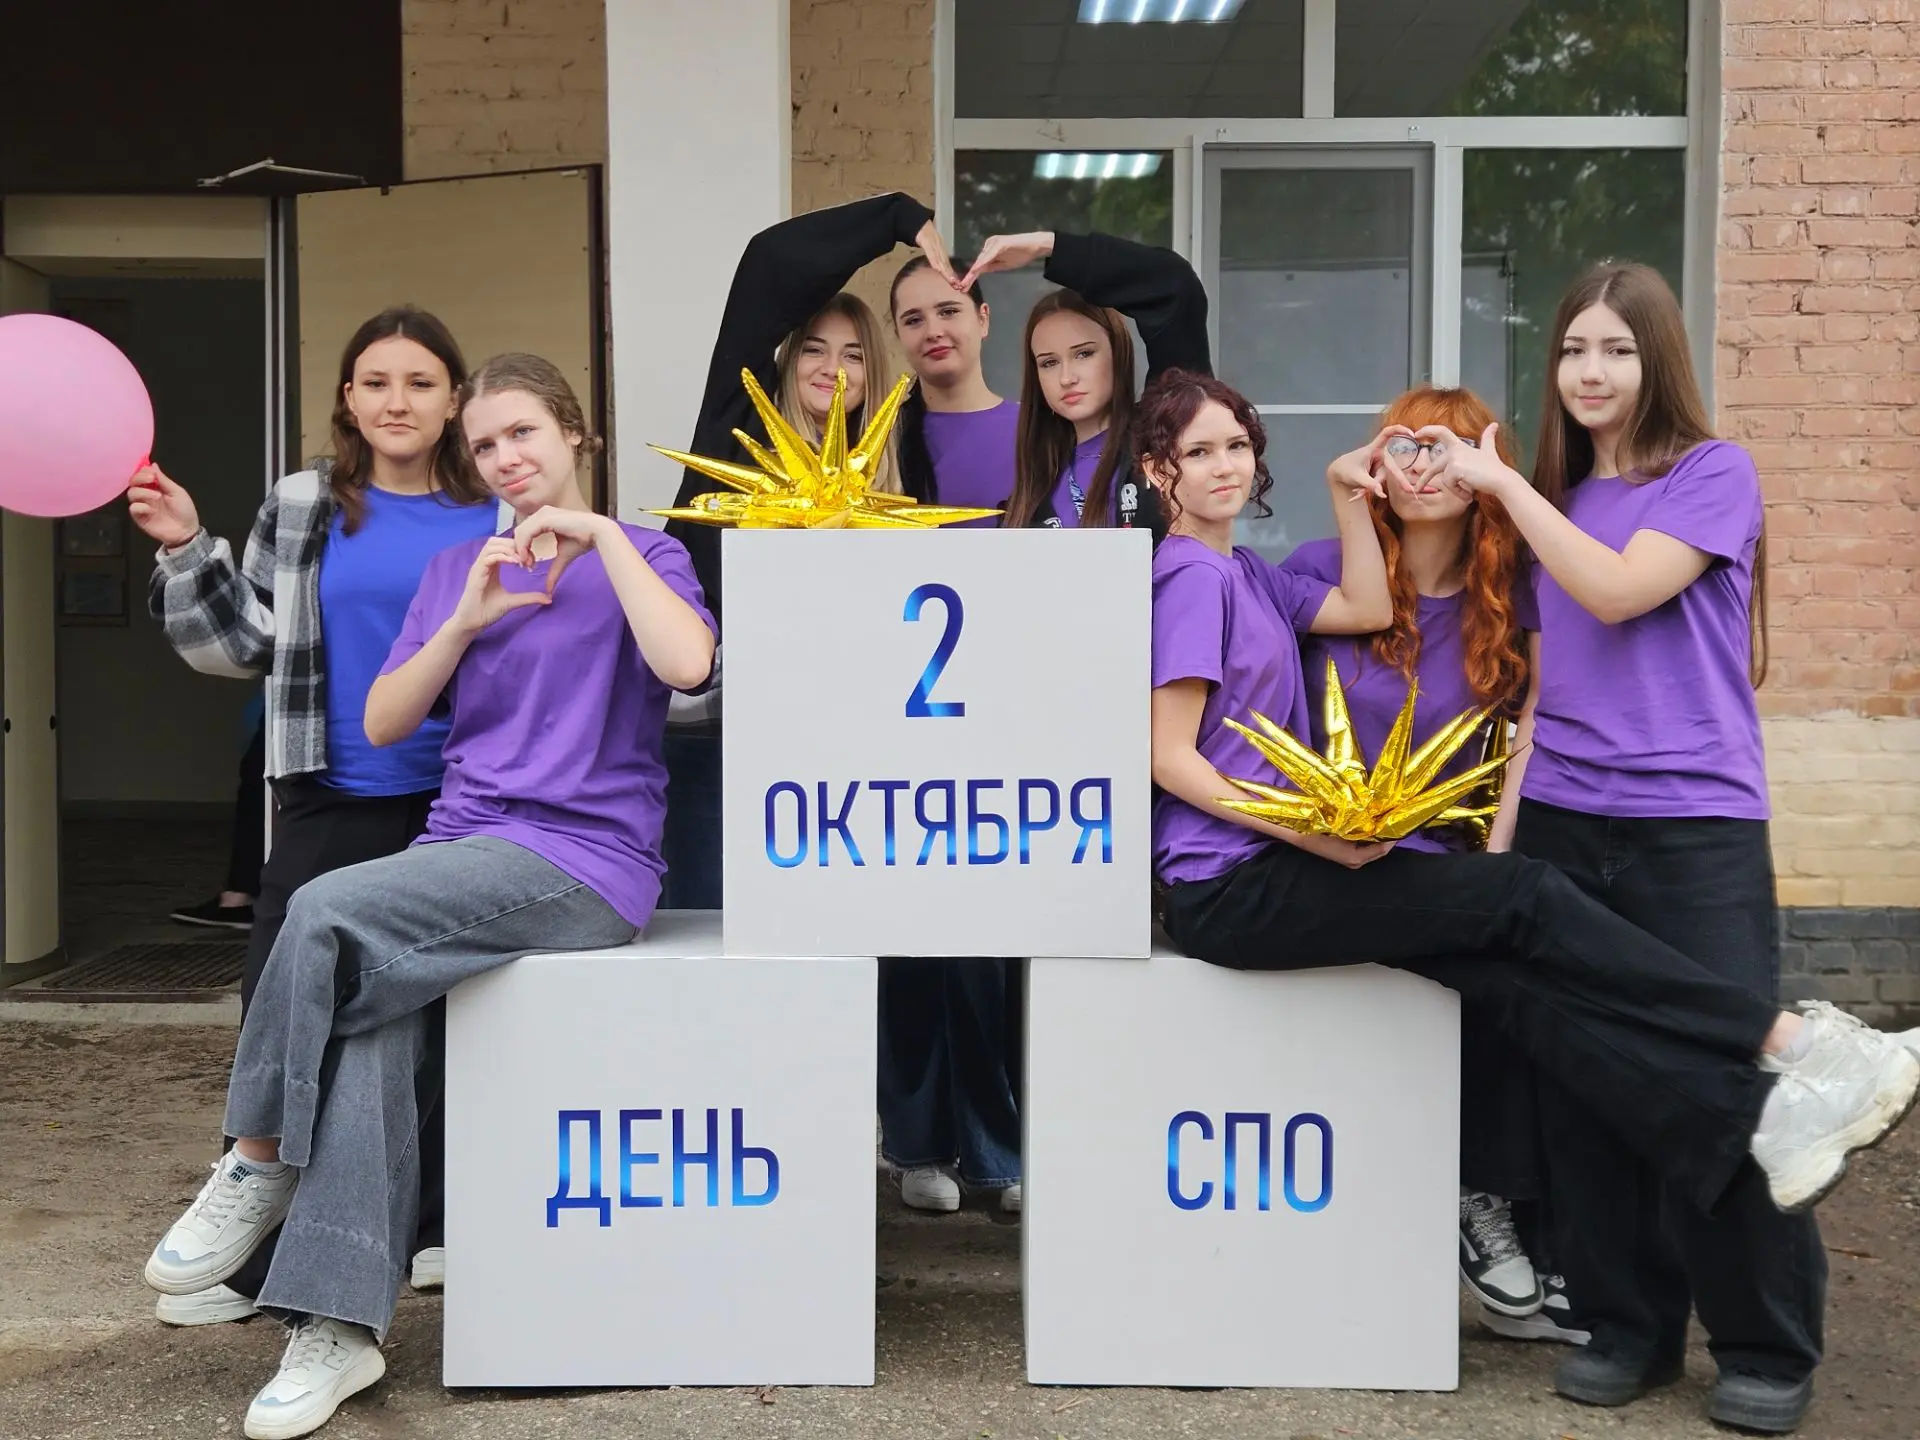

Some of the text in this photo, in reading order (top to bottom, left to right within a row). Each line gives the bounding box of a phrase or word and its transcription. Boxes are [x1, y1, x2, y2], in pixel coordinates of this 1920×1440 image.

[903, 583, 966, 717] 2
[765, 777, 1113, 868] ОКТЯБРЯ
[547, 1109, 780, 1227] ДЕНЬ
[1167, 1110, 1334, 1213] СПО
